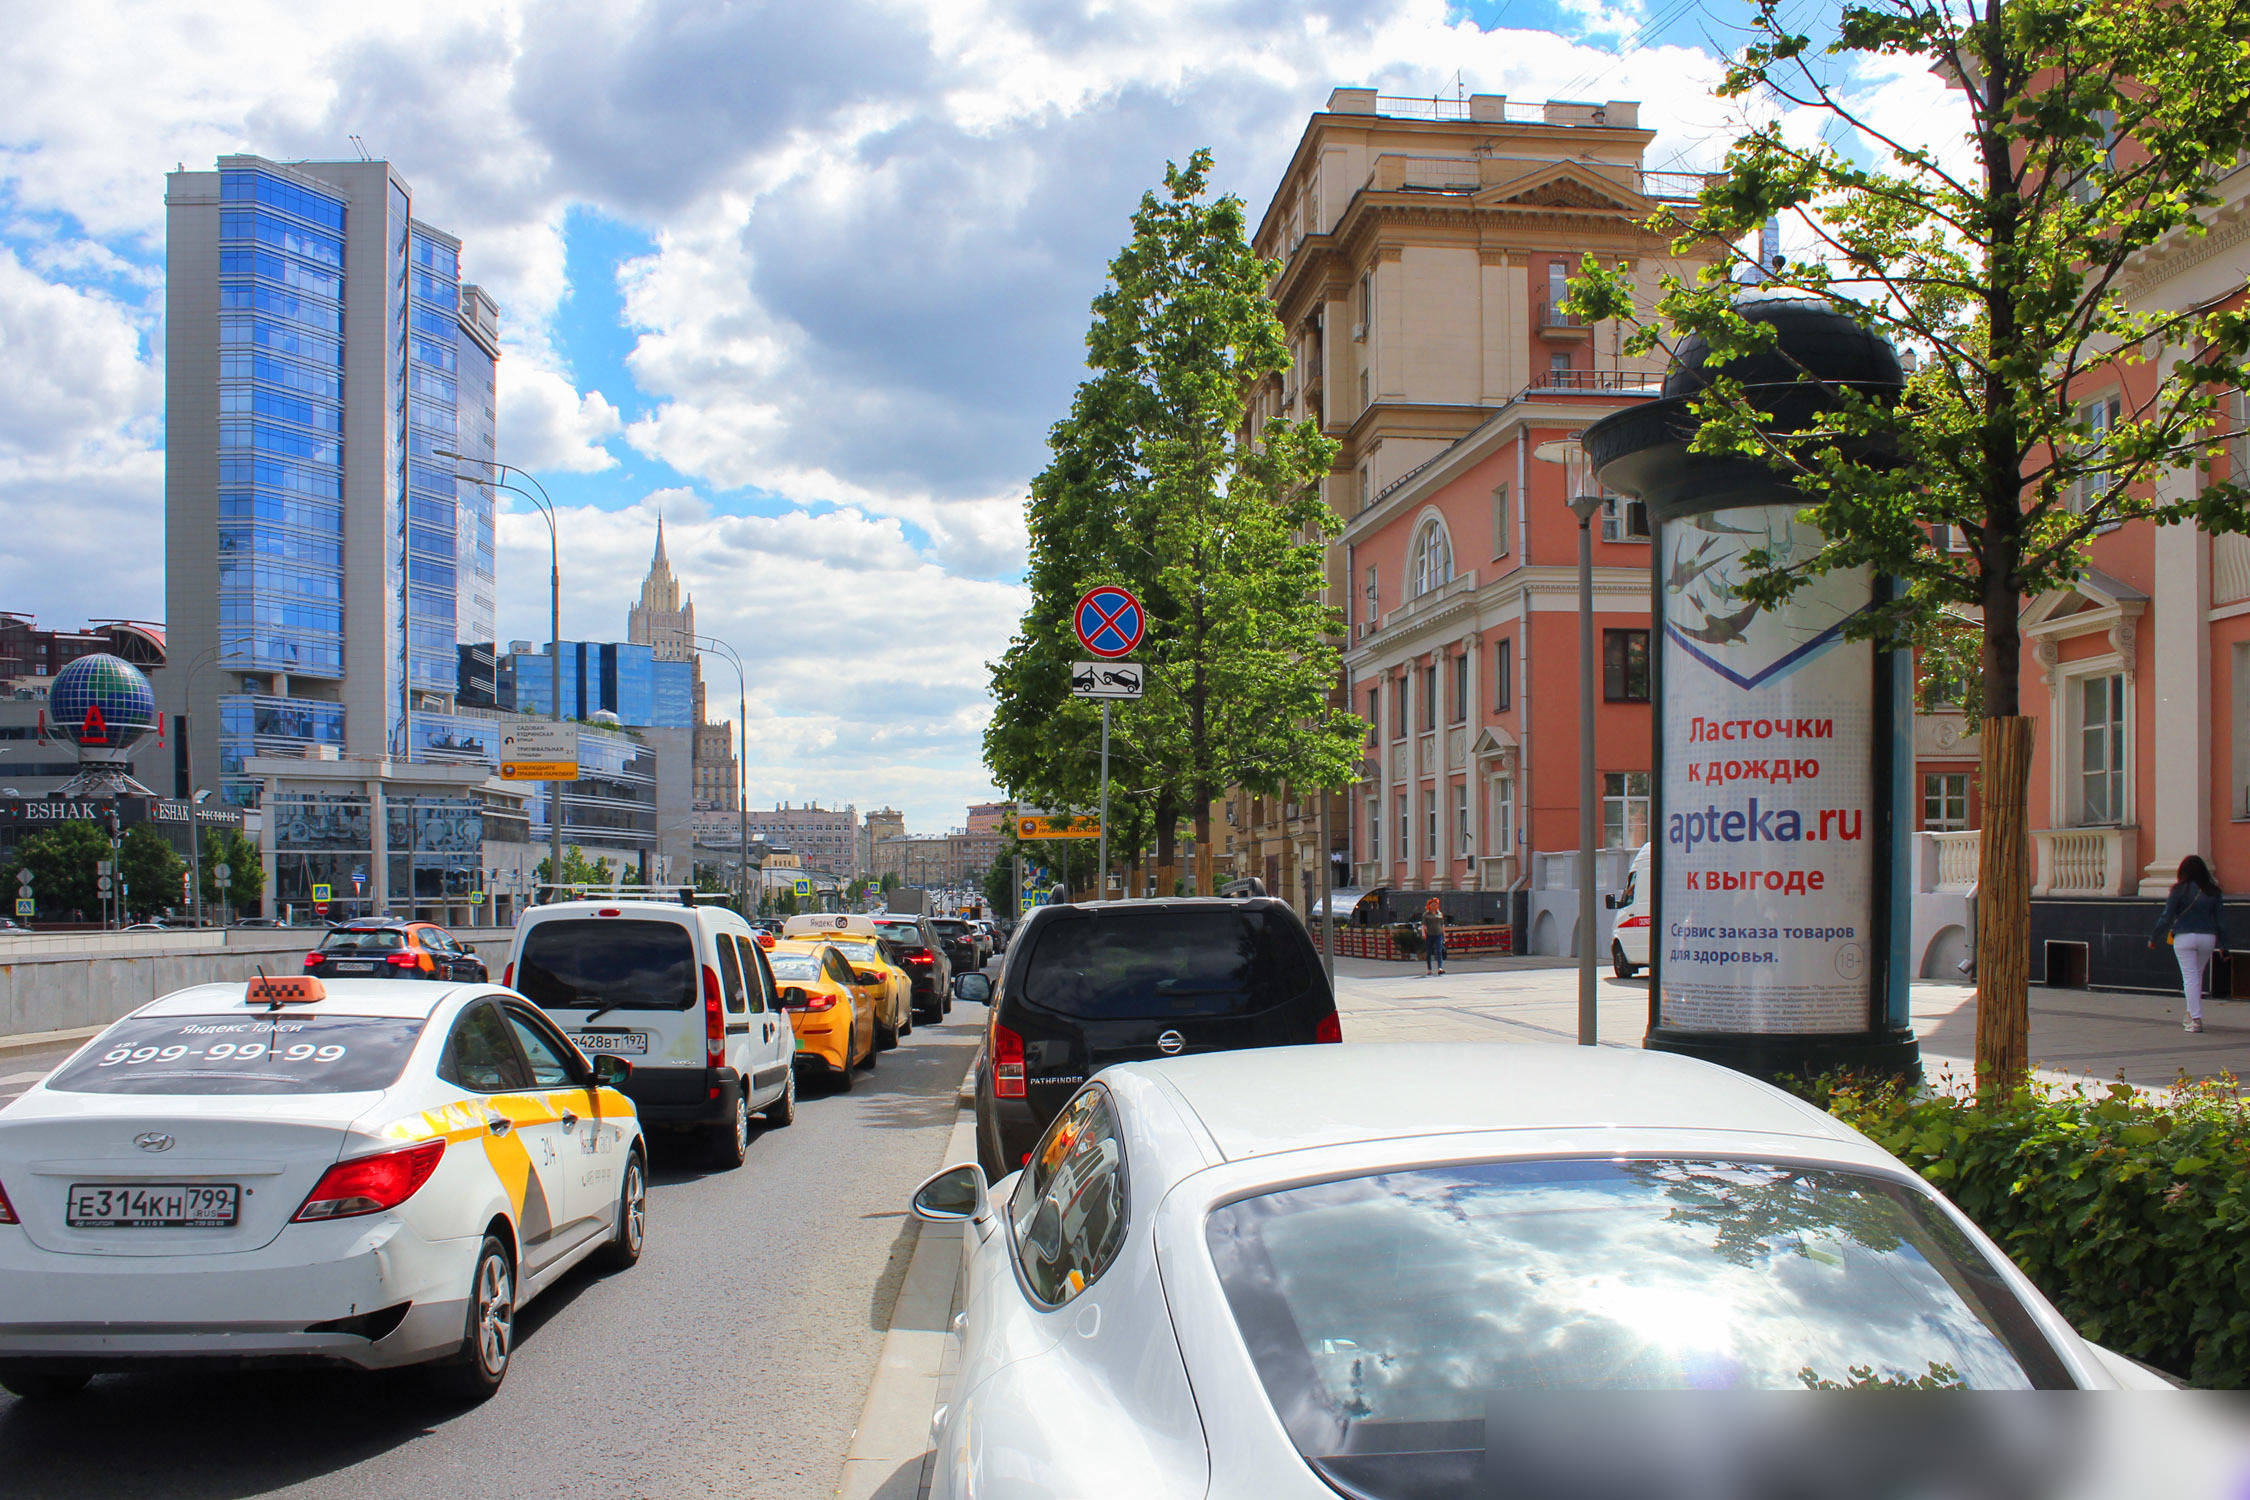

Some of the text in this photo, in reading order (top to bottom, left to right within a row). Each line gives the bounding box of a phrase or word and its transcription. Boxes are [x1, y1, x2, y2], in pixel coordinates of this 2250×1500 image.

[1689, 717, 1833, 743] Ласточки
[1688, 759, 1820, 786] к дождю
[25, 803, 96, 819] ESHAK
[158, 803, 190, 821] ESHAK
[1669, 798, 1862, 853] apteka.ru
[1687, 870, 1825, 896] к выгоде
[809, 917, 847, 928] Яндекс Go
[1671, 923, 1855, 942] Сервис заказа товаров
[1670, 949, 1779, 965] для здоровья.
[1839, 953, 1863, 969] 18+
[179, 1022, 304, 1035] Яндекс Такси
[114, 1041, 139, 1049] 495
[623, 1035, 643, 1045] 197
[98, 1043, 347, 1067] 999-99-99
[1030, 1076, 1084, 1085] PATHFINDER
[541, 1136, 557, 1167] 314
[188, 1189, 229, 1210] 799
[196, 1209, 217, 1218] RUS
